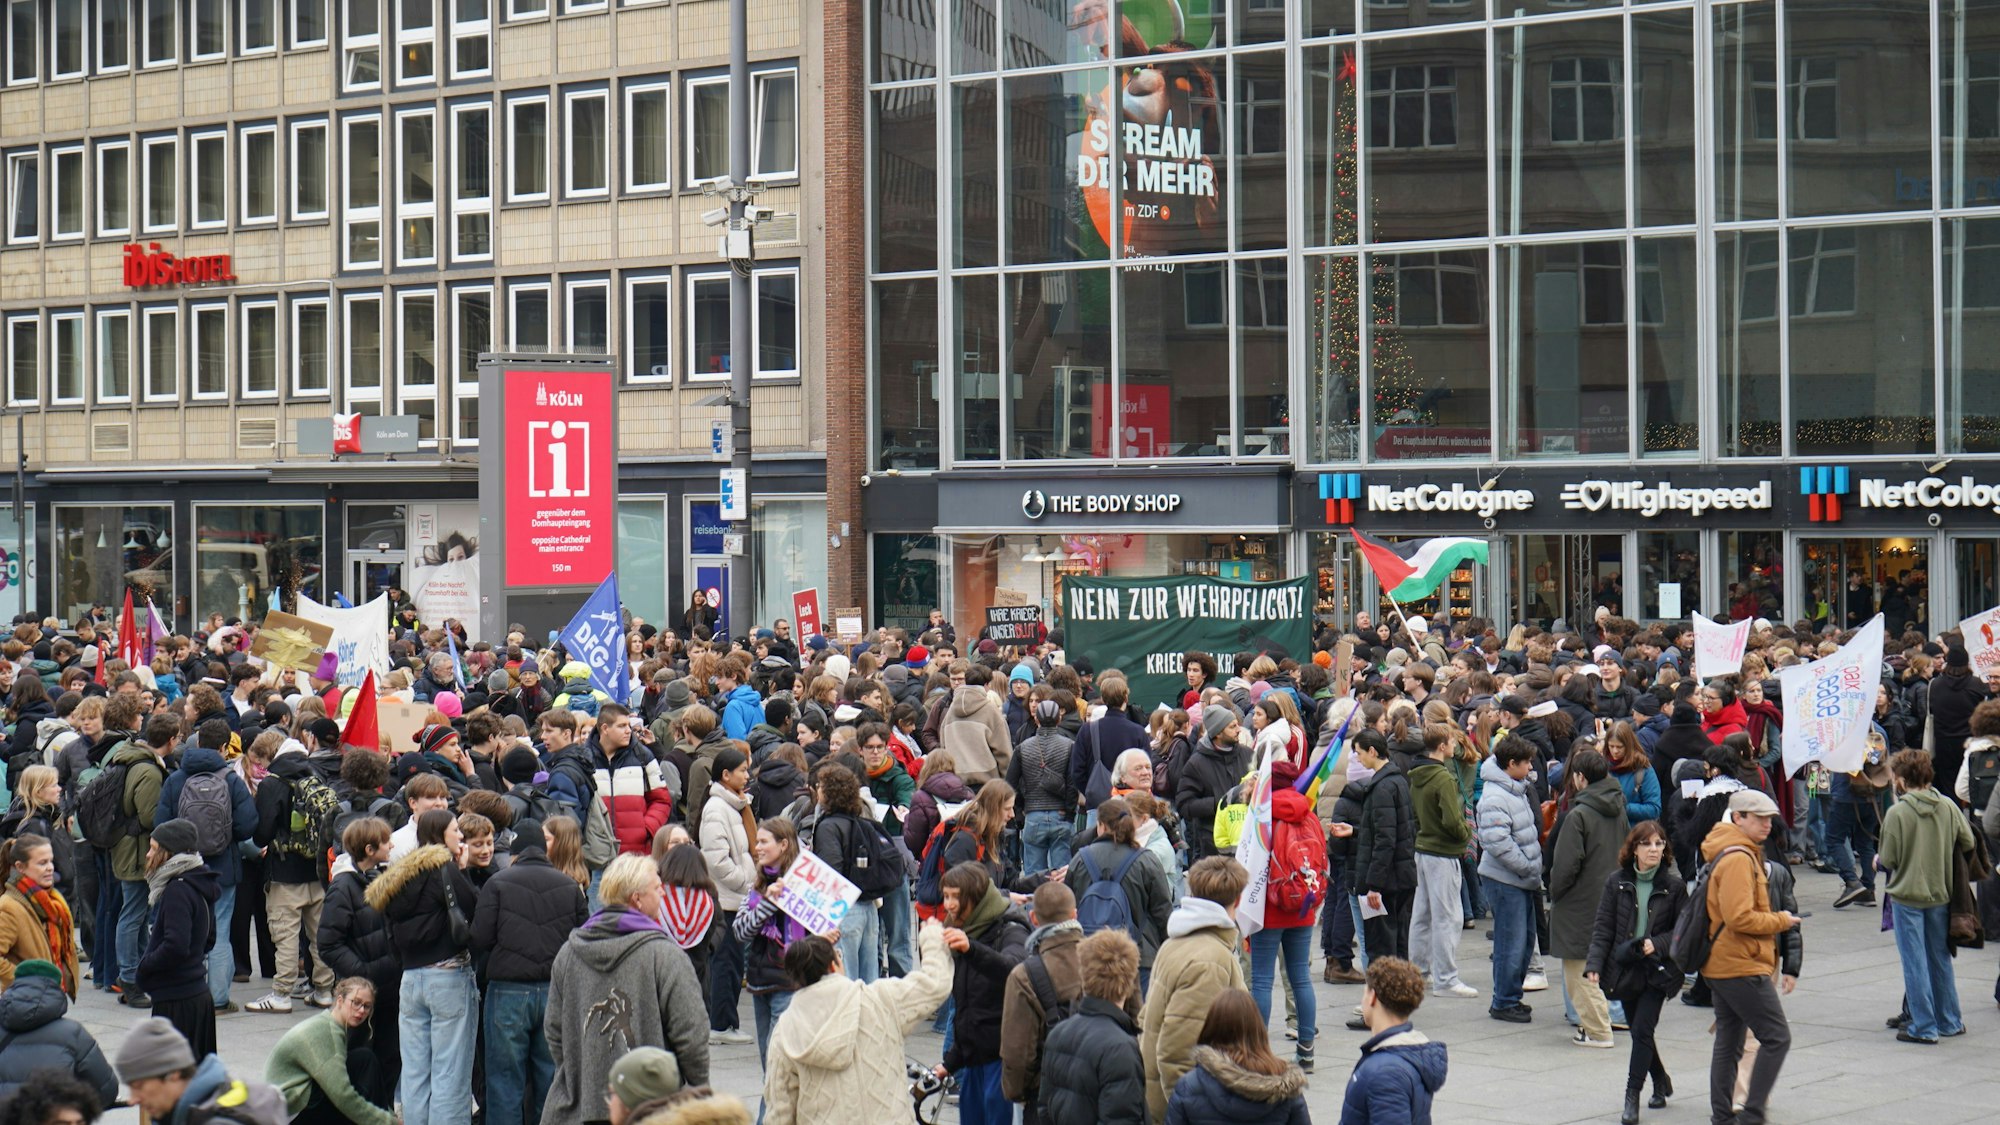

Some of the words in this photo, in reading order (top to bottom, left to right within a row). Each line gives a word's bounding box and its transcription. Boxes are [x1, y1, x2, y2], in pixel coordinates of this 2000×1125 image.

[1137, 159, 1214, 196] MEHR
[1138, 204, 1158, 218] ZDF
[124, 242, 174, 286] ibis
[174, 254, 237, 284] HOTEL
[549, 390, 583, 406] KÖLN
[333, 423, 352, 440] ibis
[376, 430, 388, 438] Köln
[396, 430, 409, 438] Dom
[1050, 495, 1082, 512] THE
[1087, 495, 1133, 512] BODY
[1134, 494, 1181, 512] SHOP
[1368, 483, 1535, 518] NetCologne
[1611, 480, 1772, 517] Highspeed
[536, 508, 571, 519] gegenüber
[571, 508, 586, 517] dem
[531, 518, 591, 529] Domhaupteingang
[694, 525, 732, 535] reisebank
[531, 535, 559, 546] opposite
[559, 535, 591, 544] Cathedral
[538, 544, 555, 553] main
[555, 544, 584, 553] entrance
[1244, 542, 1266, 555] SCENT
[552, 563, 564, 572] 150
[1070, 587, 1120, 620] NEIN
[1128, 587, 1168, 620] ZUR
[1177, 584, 1303, 620] WEHRPFLICHT!
[990, 608, 1009, 622] IHRE
[1010, 607, 1037, 622] KRIEGE
[989, 624, 1015, 640] UNSER
[1015, 622, 1036, 639] BLUT
[778, 885, 836, 934] FREIHEIT
